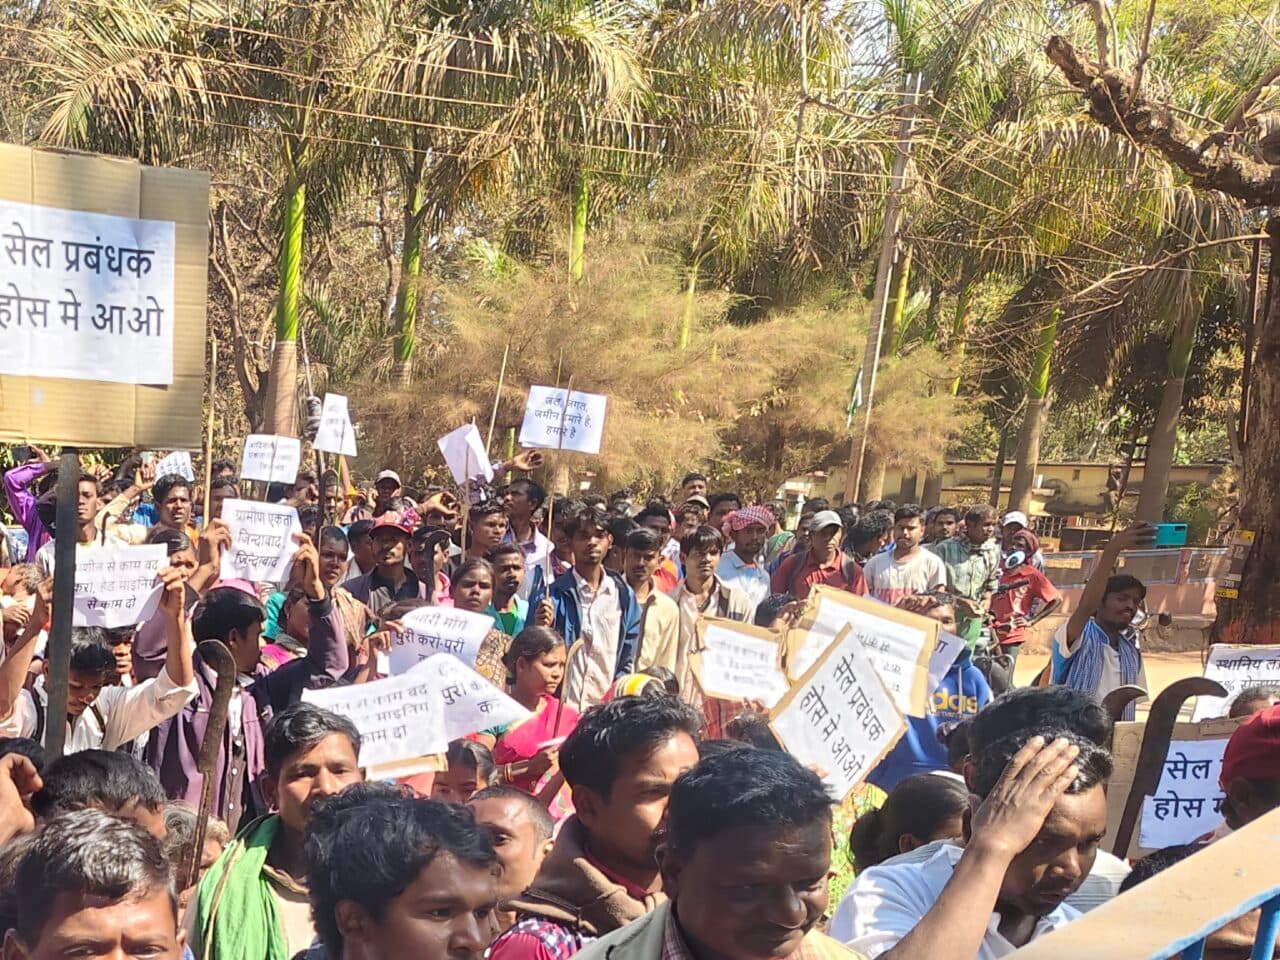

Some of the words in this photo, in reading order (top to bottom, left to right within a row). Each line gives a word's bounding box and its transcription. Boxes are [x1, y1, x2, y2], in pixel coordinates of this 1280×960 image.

[2, 222, 54, 269] सेल
[61, 235, 156, 279] प्रबंधक
[58, 289, 82, 332] मे
[91, 296, 164, 337] आओ
[800, 685, 829, 728] होस
[833, 652, 857, 695] सेल
[848, 686, 885, 742] प्रबंधक
[822, 714, 841, 742] मे
[831, 736, 865, 782] आओ
[1164, 752, 1213, 780] सेल
[1153, 790, 1206, 821] होस
